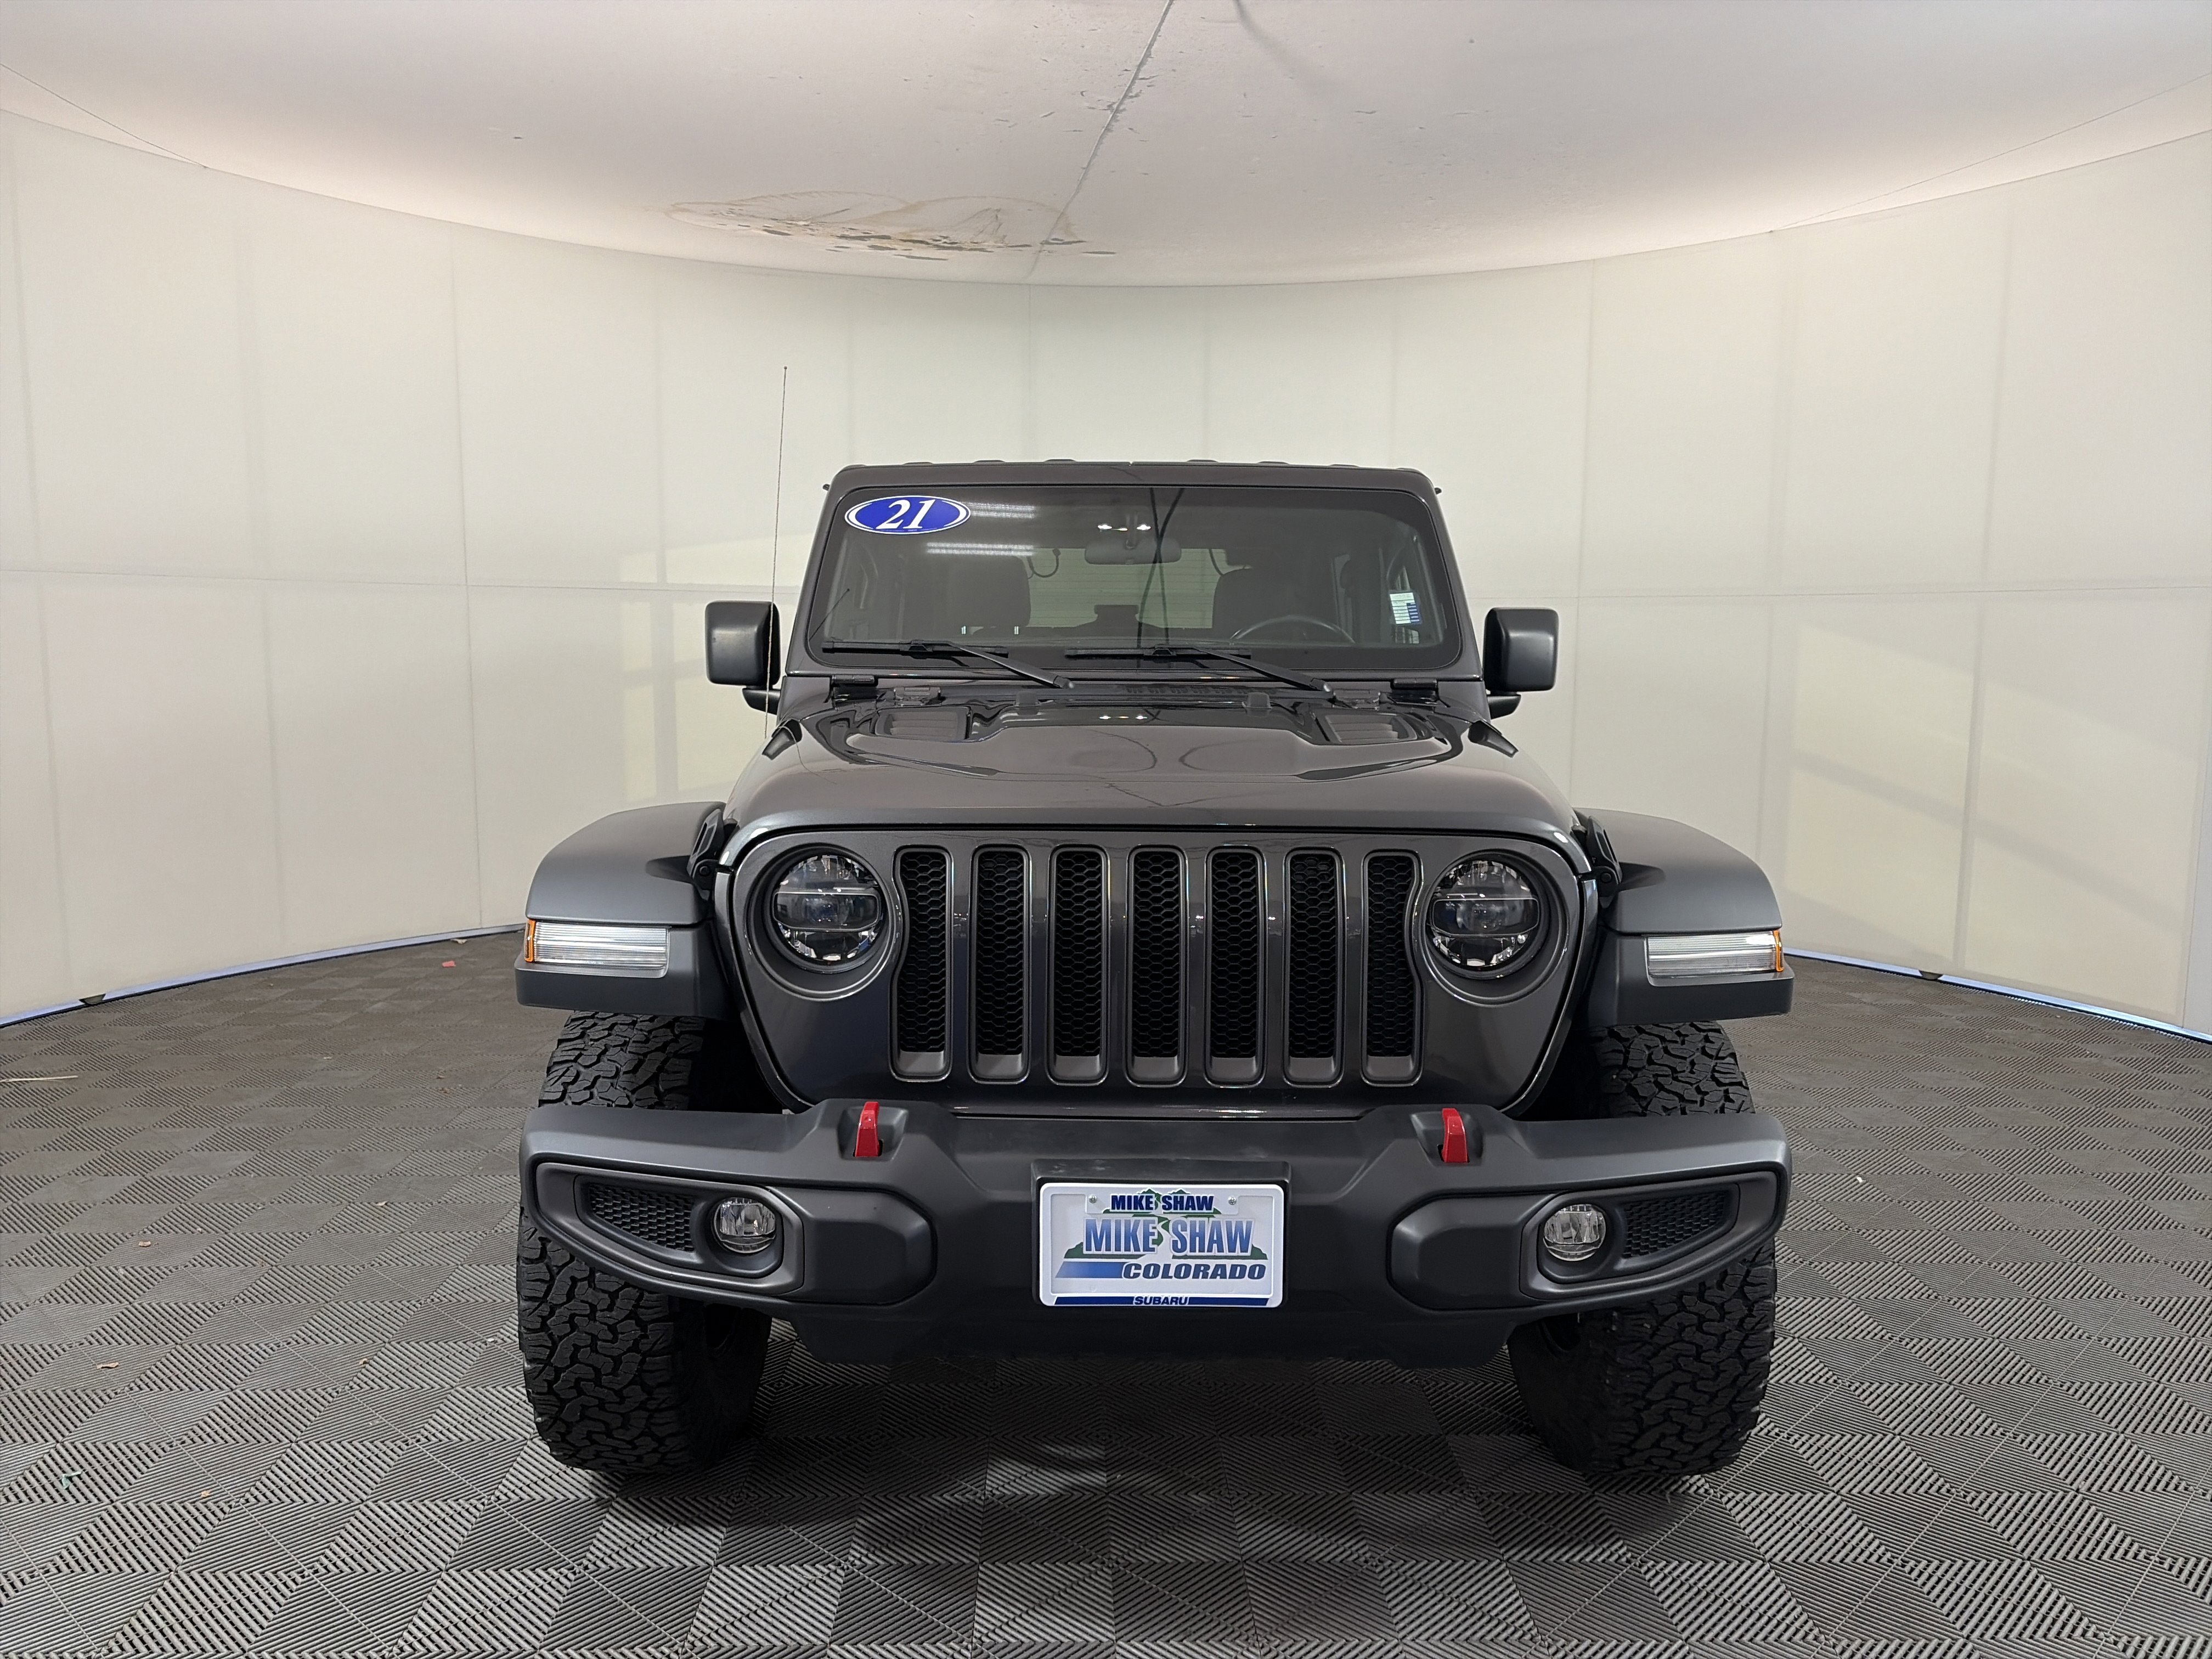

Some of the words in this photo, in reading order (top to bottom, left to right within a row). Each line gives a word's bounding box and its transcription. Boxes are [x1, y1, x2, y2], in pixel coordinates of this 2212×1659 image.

[876, 499, 936, 529] 21
[1110, 1195, 1154, 1211] MIKE
[1161, 1195, 1214, 1211] SHAW
[1085, 1219, 1156, 1252] MIKE
[1171, 1220, 1252, 1254] SHAW
[1123, 1263, 1266, 1280] COLORADO
[1134, 1296, 1188, 1305] SUBARU
